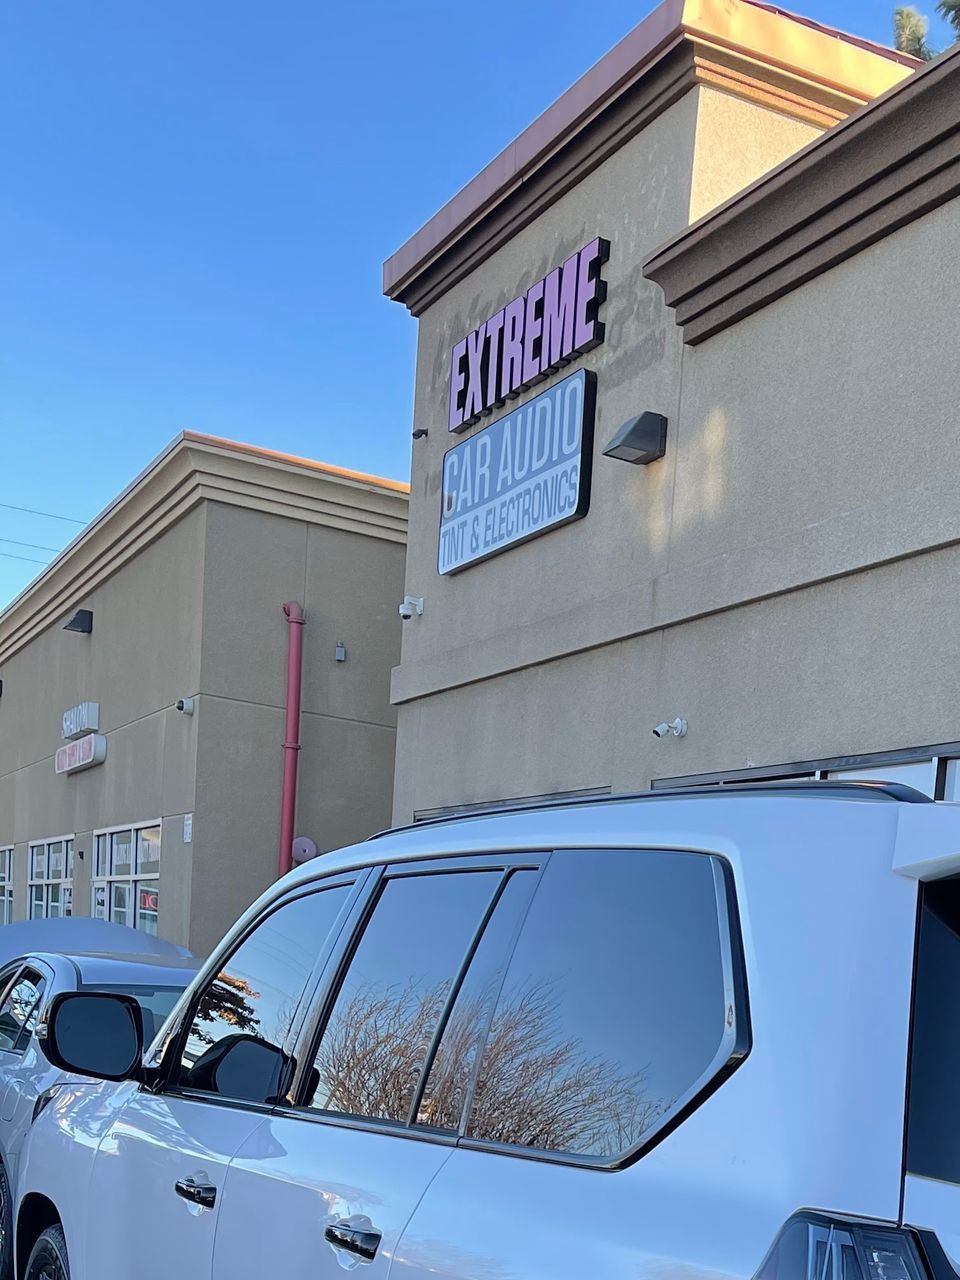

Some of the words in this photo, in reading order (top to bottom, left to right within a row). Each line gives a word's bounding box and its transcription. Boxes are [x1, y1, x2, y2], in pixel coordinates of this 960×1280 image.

[449, 237, 601, 433] EXTREME
[442, 520, 467, 567] TINT
[471, 515, 479, 553] &
[484, 464, 578, 548] ELECTRONICS
[443, 435, 491, 520] CAR
[497, 378, 582, 492] AUDIO
